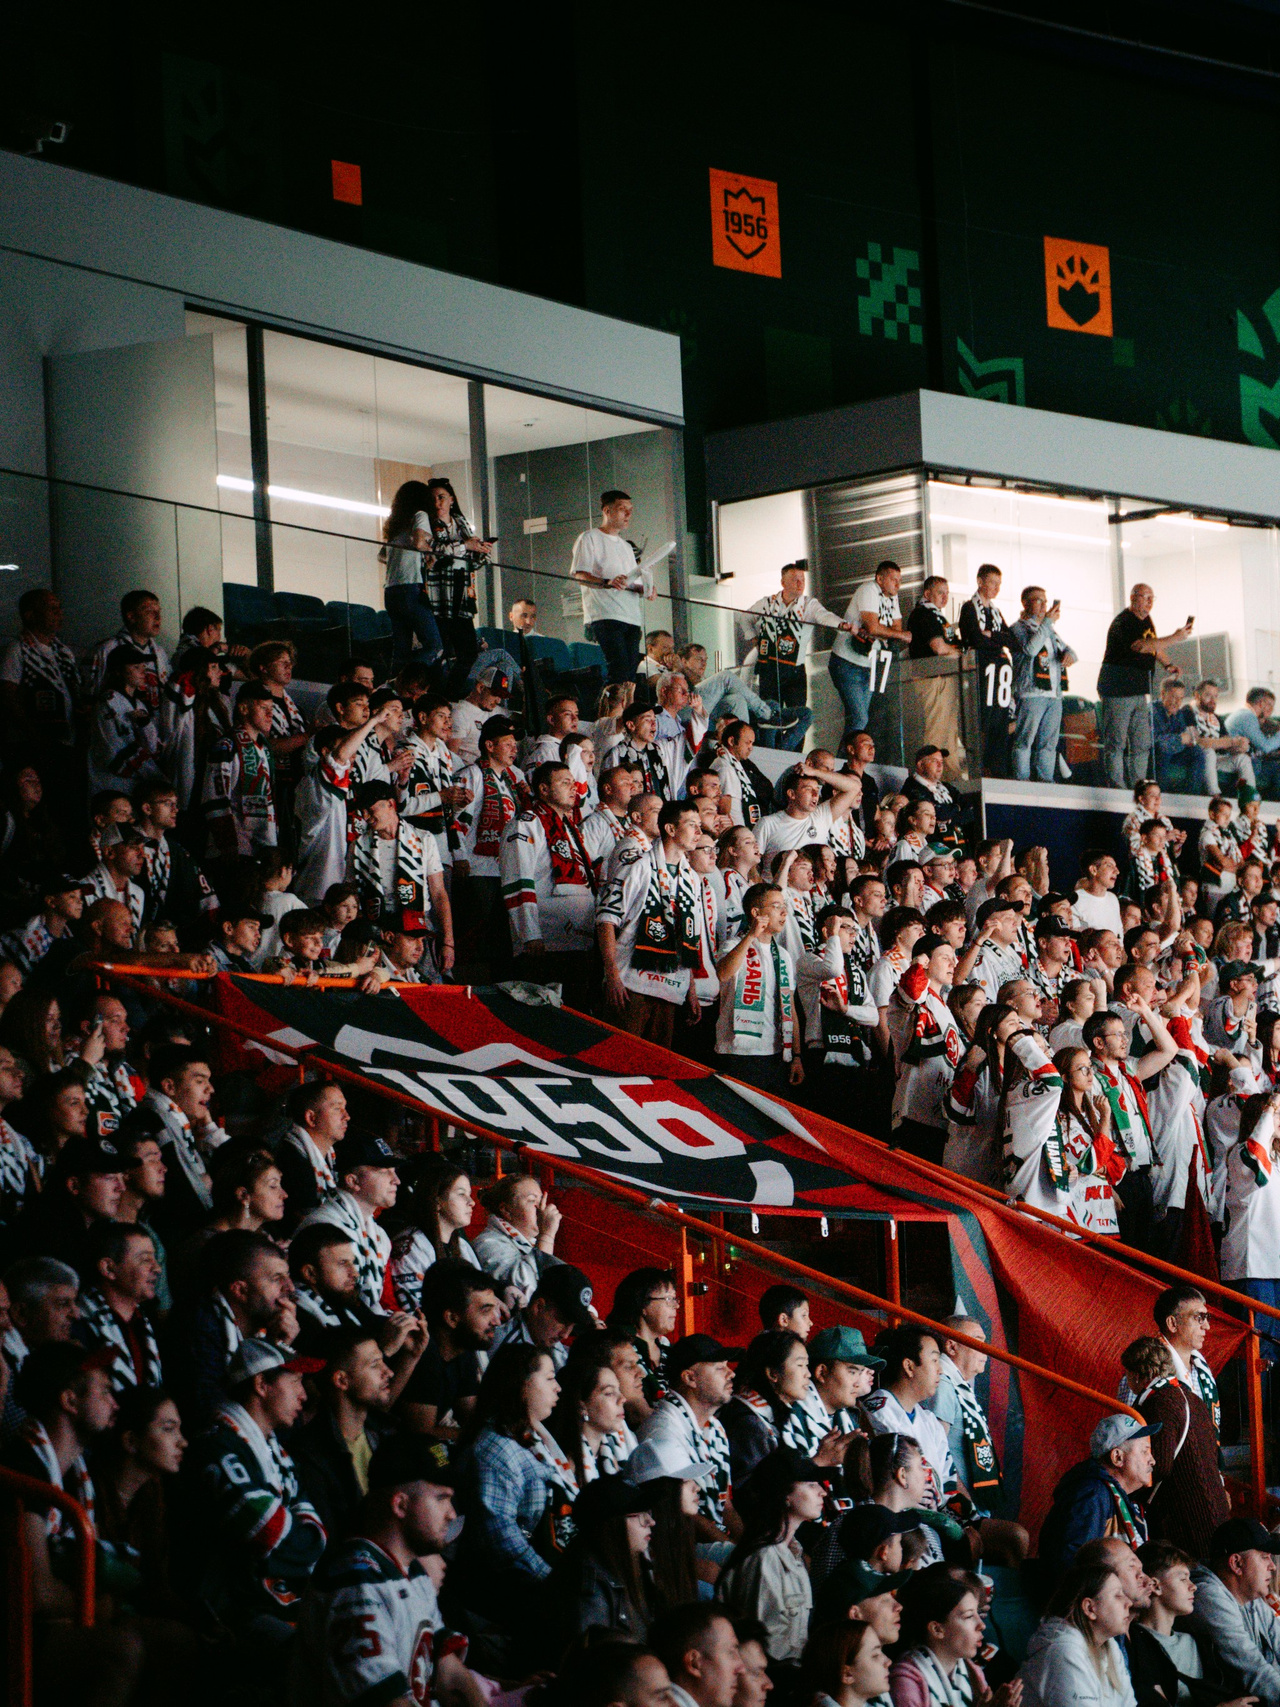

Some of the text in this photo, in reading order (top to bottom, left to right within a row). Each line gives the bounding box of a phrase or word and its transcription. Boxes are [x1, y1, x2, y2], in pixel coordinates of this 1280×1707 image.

[723, 209, 767, 239] 1956
[868, 646, 893, 693] 17
[985, 663, 1013, 708] 18
[828, 1034, 852, 1045] 1956
[362, 1066, 746, 1163] 1956
[1065, 1134, 1089, 1160] 27
